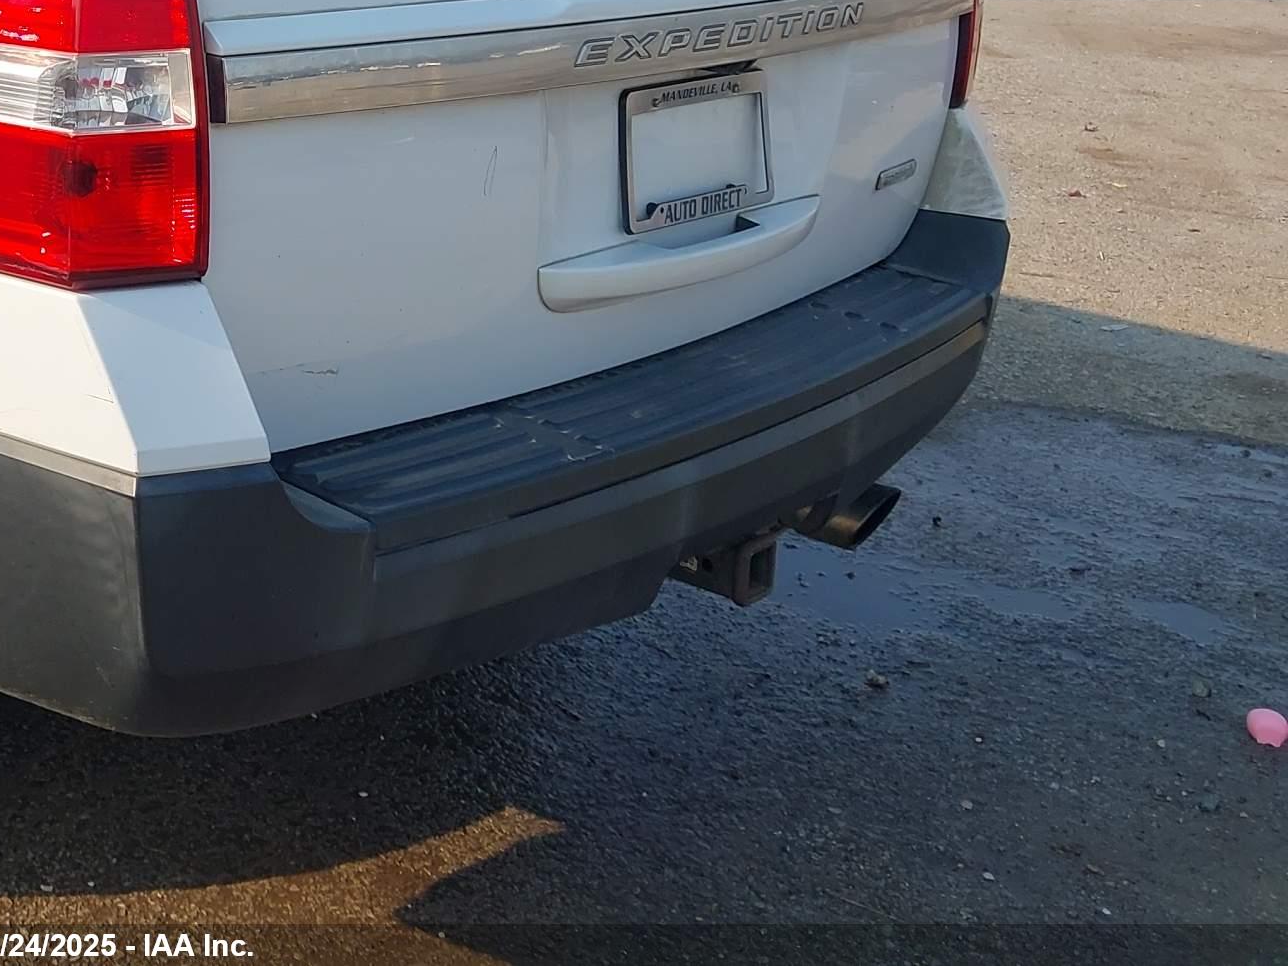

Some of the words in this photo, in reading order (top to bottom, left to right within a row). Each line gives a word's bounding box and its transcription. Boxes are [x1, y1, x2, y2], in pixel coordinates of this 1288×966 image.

[574, 2, 865, 68] EXPEDITION
[664, 199, 697, 225] AUTO
[701, 188, 742, 215] DIRECT
